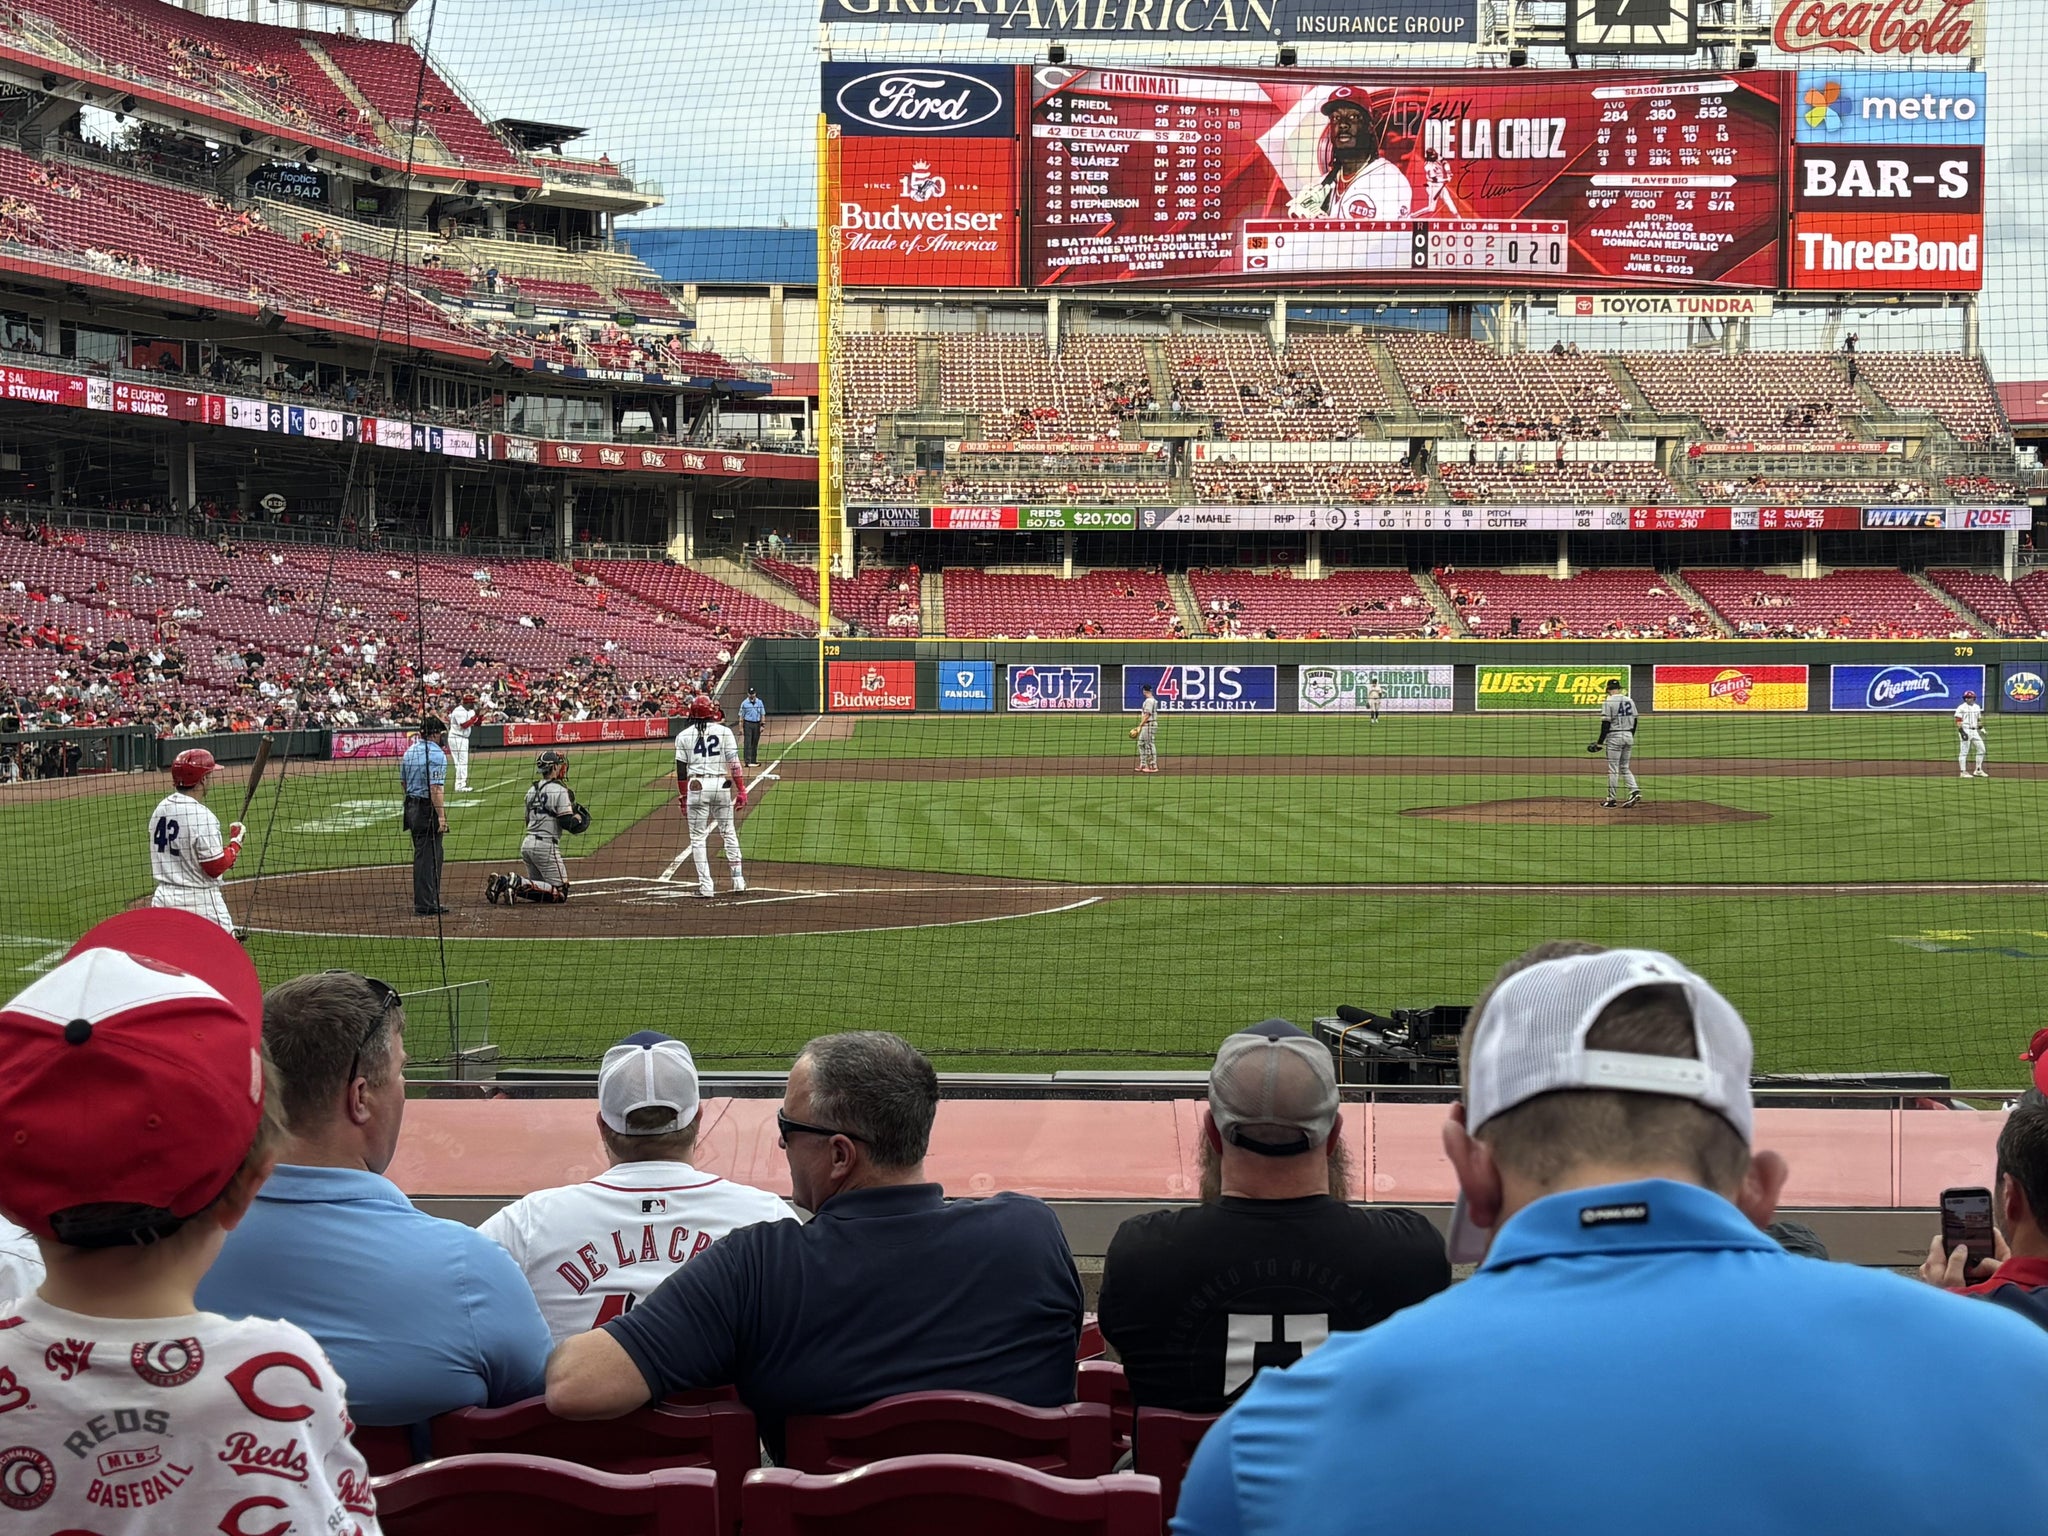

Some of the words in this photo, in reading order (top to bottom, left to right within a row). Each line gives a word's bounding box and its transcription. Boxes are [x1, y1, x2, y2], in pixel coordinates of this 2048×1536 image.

[1000, 0, 1277, 32] AMERICAN
[1297, 16, 1398, 34] INSURANCE
[1404, 16, 1465, 34] GROUP
[1774, 0, 1973, 54] Coca-Cola
[1100, 73, 1180, 94] CINCINNATI
[1625, 86, 1664, 96] SEASON
[1666, 84, 1700, 94] STATS
[869, 77, 971, 120] Ford
[1046, 98, 1062, 108] 42
[1071, 100, 1111, 110] FRIEDL
[1429, 98, 1473, 120] ELLY
[1646, 109, 1676, 120] .360
[1862, 94, 1976, 120] metro
[1046, 113, 1062, 122] 42
[1071, 114, 1118, 125] MCLAIN
[1176, 120, 1196, 128] .210
[1047, 128, 1061, 136] 42
[1072, 128, 1087, 137] DE
[1092, 129, 1106, 138] LA
[1110, 130, 1140, 139] CRUZ
[1155, 132, 1169, 140] SS
[1425, 118, 1456, 159] DE
[1462, 118, 1494, 159] LA
[1498, 118, 1567, 158] CRUZ
[1716, 133, 1729, 142] 13
[1046, 142, 1062, 150] 42
[1071, 143, 1130, 153] STEWART
[1046, 156, 1062, 165] 42
[1071, 156, 1119, 167] SUÁREZ
[263, 172, 278, 180] THE
[280, 172, 317, 186] fioptics
[1046, 171, 1062, 180] 42
[1071, 172, 1109, 181] STEER
[1804, 160, 1968, 199] BAR-S
[255, 180, 321, 198] GIGABAR
[899, 172, 946, 202] 150
[1046, 185, 1062, 194] 42
[1071, 185, 1108, 194] HINDS
[1175, 186, 1196, 194] .000
[1711, 191, 1731, 199] B/T
[1046, 200, 1062, 209] 42
[1071, 199, 1139, 208] STEPHENSON
[1631, 200, 1655, 209] 200
[1676, 200, 1693, 210] 24
[1708, 201, 1735, 211] S/R
[840, 203, 1002, 231] Budweiser
[1046, 214, 1062, 224] 42
[1071, 213, 1112, 223] HAYES
[1626, 221, 1648, 229] JAN
[1665, 223, 1693, 231] 2002
[1047, 239, 1059, 247] IS
[1062, 237, 1111, 247] BATTING
[1188, 233, 1207, 242] THE
[1208, 233, 1233, 241] LAST
[1591, 229, 1634, 238] SABANA
[1636, 230, 1680, 240] GRANDE
[1700, 233, 1734, 242] BOYA
[840, 232, 896, 251] Made
[900, 234, 922, 255] of
[918, 234, 998, 251] America
[1068, 247, 1079, 255] 11
[1083, 245, 1121, 255] GAMES
[1124, 244, 1150, 253] WITH
[1276, 236, 1284, 248] 0
[1415, 234, 1425, 248] 0
[1509, 241, 1518, 264] 0
[1530, 242, 1538, 264] 2
[1550, 242, 1559, 265] 0
[1603, 239, 1662, 248] DOMINICAN
[1665, 241, 1719, 251] REPUBLIC
[1048, 256, 1101, 266] HOMERS,
[1148, 252, 1176, 260] RUNS
[1195, 249, 1232, 258] STOLEN
[1653, 255, 1687, 263] DEBUT
[1798, 232, 1977, 271] ThreeBond
[1129, 261, 1164, 270] BASES
[1415, 253, 1425, 266] 0
[1624, 263, 1651, 272] JUNE
[1666, 265, 1694, 274] 2023
[1601, 298, 1672, 313] TOYOTA
[1677, 298, 1754, 313] TUNDRA
[586, 370, 606, 380] TRIPLE
[608, 370, 622, 380] PLAY
[623, 371, 643, 382] SUITES
[8, 373, 26, 385] SAL
[97, 385, 111, 396] THE
[9, 386, 59, 402] STEWART
[91, 395, 110, 404] HOLE
[117, 387, 128, 398] 42
[131, 388, 165, 403] EUGENIO
[117, 402, 127, 412] DH
[131, 401, 168, 416] SUÁREZ
[231, 406, 239, 420] 9
[254, 408, 261, 422] 5
[310, 417, 317, 430] 0
[330, 420, 338, 432] 0
[1196, 445, 1205, 460] K
[830, 446, 841, 489] HIT
[880, 508, 919, 519] TOWNE
[950, 509, 1001, 520] MIKE'S
[1030, 509, 1061, 518] REDS
[1073, 512, 1131, 526] $20,700
[1177, 515, 1190, 523] 42
[1196, 515, 1231, 523] MAHLE
[1274, 515, 1294, 523] RHP
[1634, 509, 1647, 518] 42
[1655, 509, 1706, 518] STEWART
[1763, 509, 1776, 518] 42
[1784, 508, 1824, 518] SUÁREZ
[1867, 510, 1944, 526] WLWT5
[1964, 510, 2012, 528] ROSE
[1027, 519, 1064, 528] 50/50
[1379, 519, 1395, 528] 0.0
[1488, 519, 1527, 527] CUTTER
[1578, 519, 1590, 527] 88
[1656, 520, 1674, 528] AVG
[1678, 519, 1697, 528] .310
[1806, 519, 1824, 527] .217
[824, 646, 840, 655] 328
[1954, 647, 1973, 656] 379
[1038, 668, 1094, 700] utz
[1156, 666, 1242, 700] 4BIS
[1340, 670, 1429, 692] Document
[1479, 672, 1552, 693] WEST
[1711, 677, 1752, 696] Kahn's
[945, 690, 986, 698] FANDUEL
[1355, 685, 1451, 706] Dstruction
[1874, 678, 1930, 701] Charmin
[833, 691, 912, 707] Budweiser
[1040, 698, 1092, 708] BRANDS
[1191, 701, 1257, 710] SECURITY
[1572, 694, 1606, 704] TIRE
[1618, 702, 1632, 716] 42
[694, 735, 720, 757] 42
[153, 816, 180, 856] 42
[556, 1241, 608, 1296] DE
[611, 1223, 659, 1268] LA
[668, 1226, 713, 1263] CR
[1254, 1258, 1277, 1277] TO
[1291, 1259, 1345, 1291] RYSE
[64, 1408, 170, 1459] REDS
[108, 1452, 146, 1468] MLB
[218, 1431, 310, 1482] Reds
[87, 1462, 194, 1508] BASEBALL
